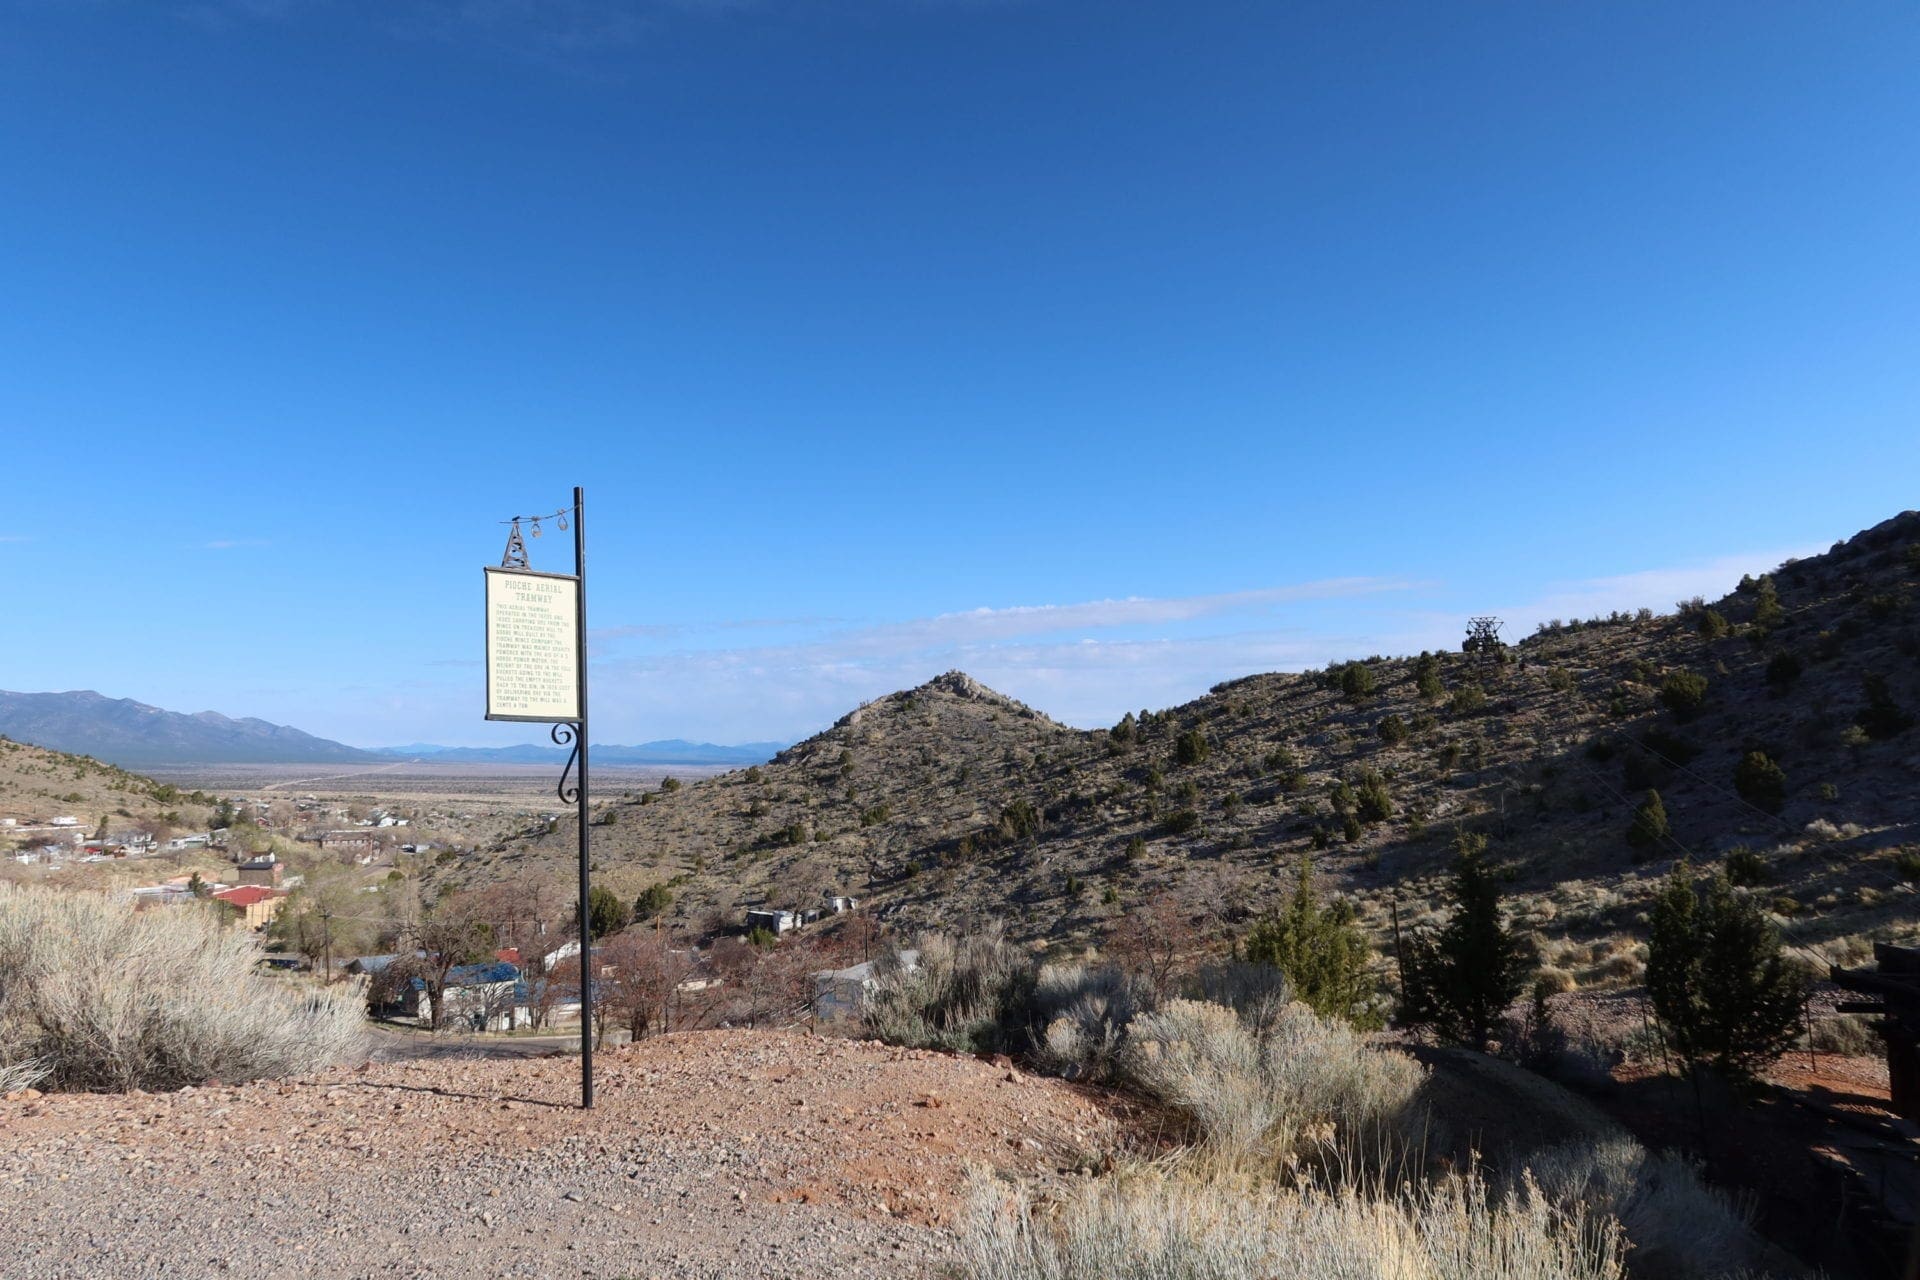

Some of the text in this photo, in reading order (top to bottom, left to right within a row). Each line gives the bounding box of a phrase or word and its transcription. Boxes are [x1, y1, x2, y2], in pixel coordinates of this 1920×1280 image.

[505, 580, 562, 594] PIOCHE AERIAL
[516, 593, 552, 603] TRAMWAY
